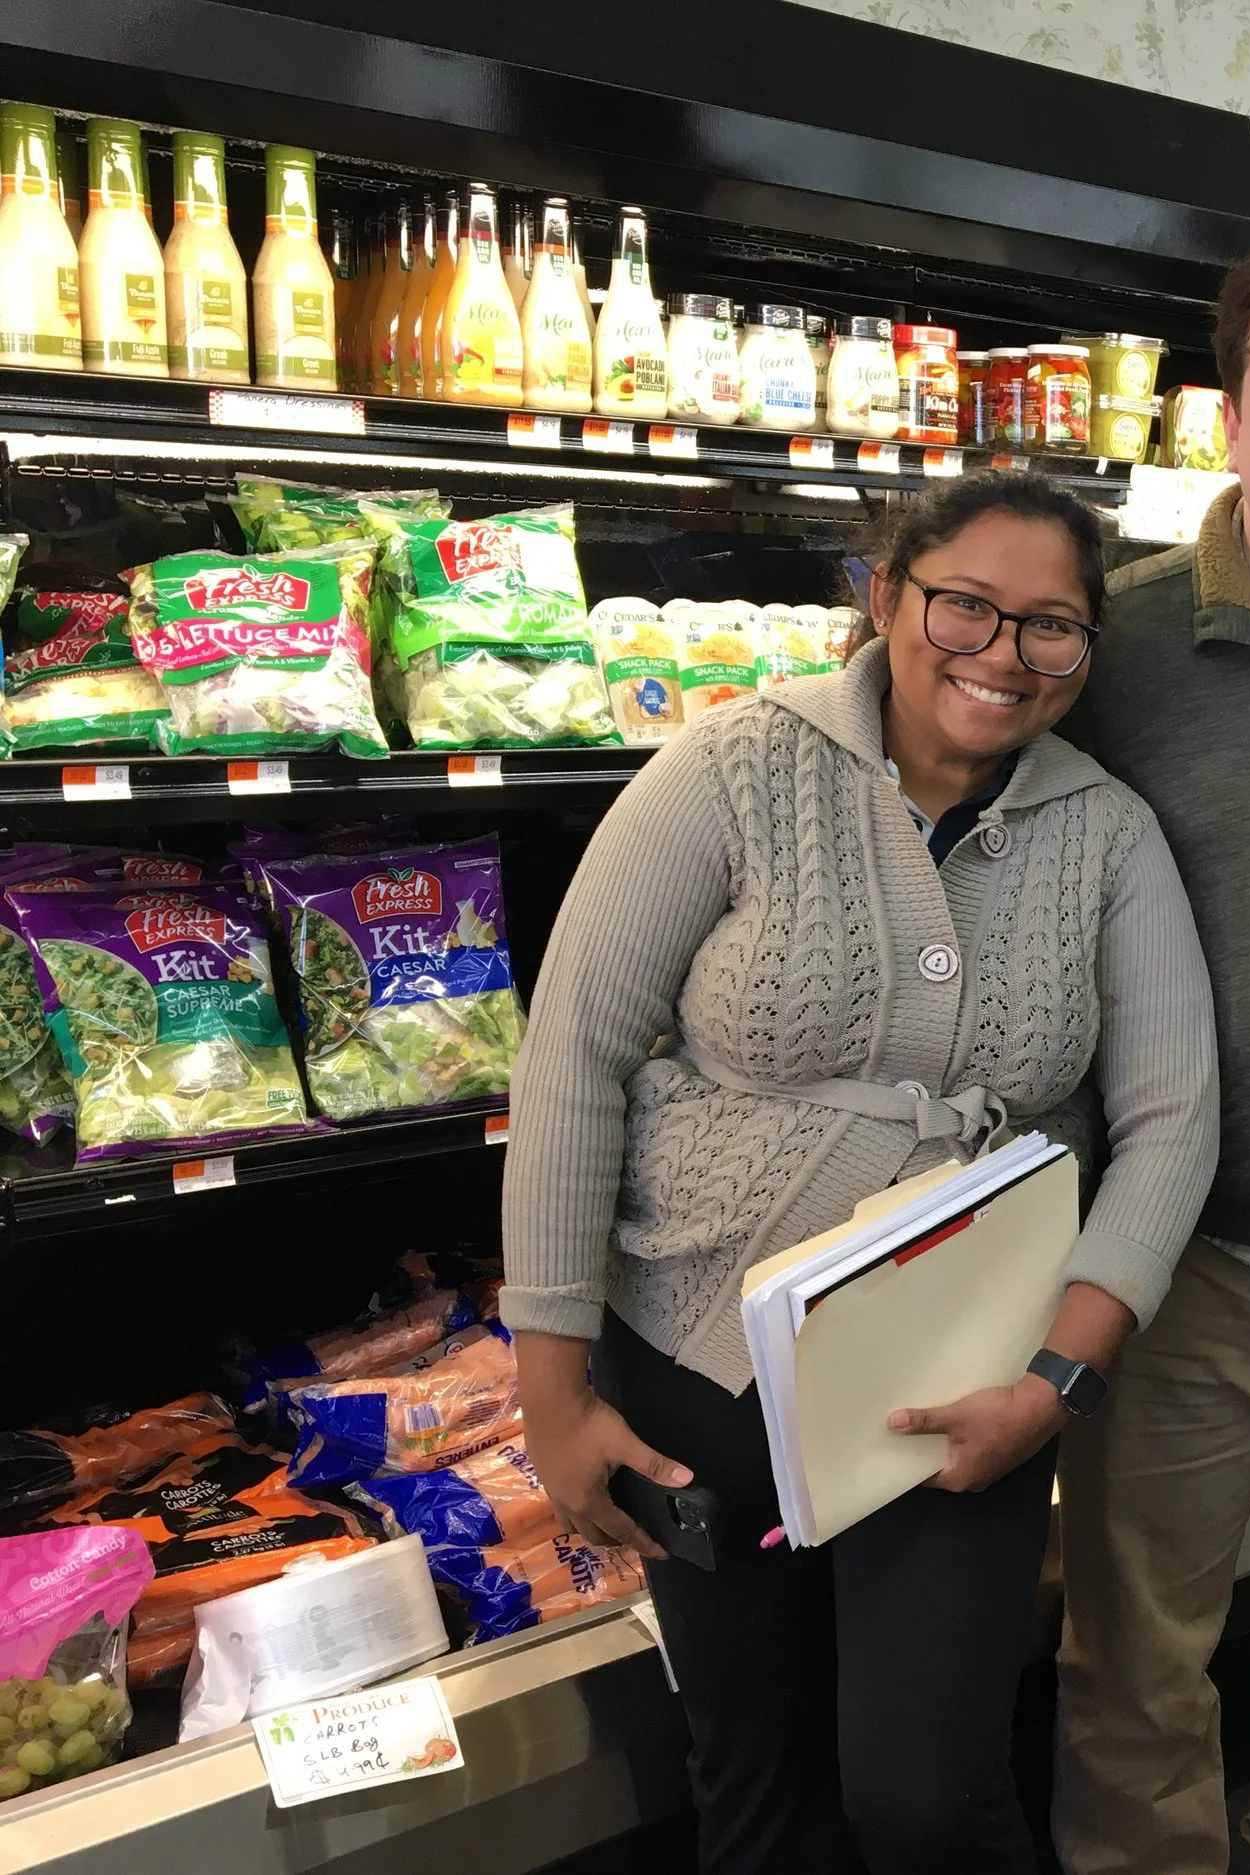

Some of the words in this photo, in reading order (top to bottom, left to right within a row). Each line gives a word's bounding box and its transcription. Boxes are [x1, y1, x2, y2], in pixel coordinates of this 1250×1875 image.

[210, 349, 228, 360] Greek
[303, 359, 320, 369] Greek
[636, 358, 665, 371] AVOCAD
[636, 372, 665, 386] POBLAN
[765, 388, 785, 400] BLUE
[454, 526, 522, 556] Fres
[206, 572, 294, 600] Fresh
[613, 612, 655, 623] CEDAR'S
[297, 624, 346, 642] MIX
[619, 658, 648, 670] SNACK
[648, 659, 672, 670] PACK
[694, 666, 725, 677] SNACK
[726, 666, 749, 677] PACK
[105, 769, 124, 782] $3.49
[266, 764, 283, 775] $3.49
[366, 873, 431, 903] Fresh
[366, 898, 433, 916] EXPRESS
[142, 905, 214, 932] Fresh
[145, 925, 216, 946] EXPRESS
[369, 924, 430, 959] Kit
[151, 950, 220, 982] Kit
[376, 958, 447, 978] CAESAR
[163, 984, 232, 1003] CAESAR
[167, 998, 244, 1019] SUPREME
[268, 1090, 287, 1101] FREE
[160, 1479, 212, 1500] CARROTS
[165, 1482, 222, 1510] CAROTTES
[210, 1530, 277, 1547] CARROTS
[29, 1560, 80, 1592] Cotton
[80, 1534, 127, 1564] Candy
[16, 1594, 54, 1619] Natural
[312, 1693, 412, 1724] PRODUCE
[304, 1716, 379, 1745] CARROTS
[350, 1737, 379, 1753] Bag
